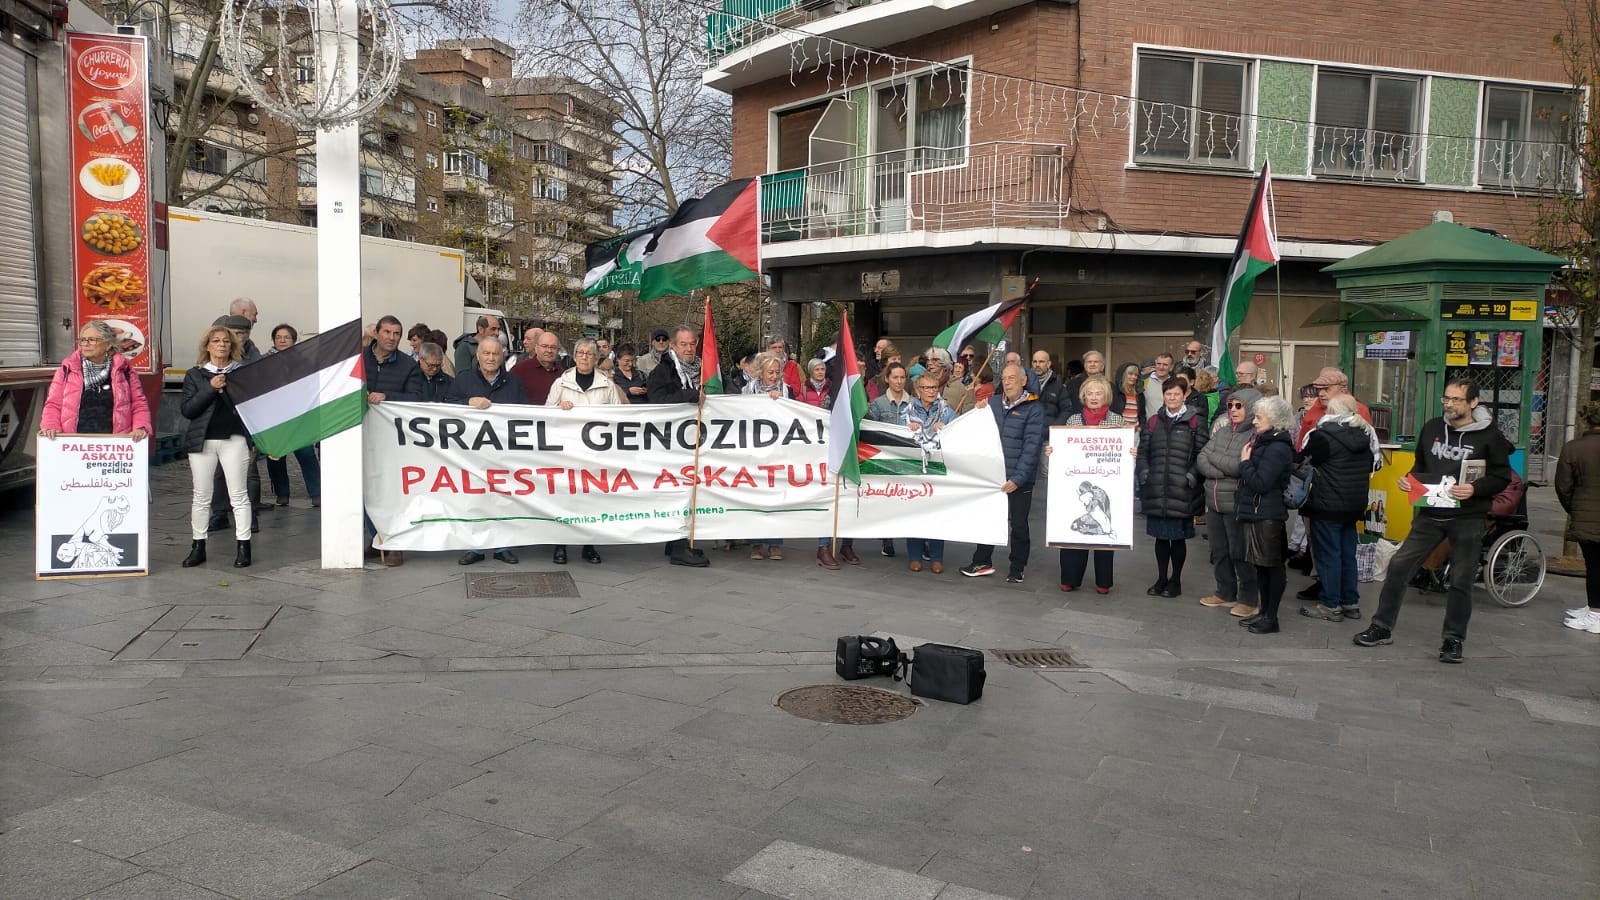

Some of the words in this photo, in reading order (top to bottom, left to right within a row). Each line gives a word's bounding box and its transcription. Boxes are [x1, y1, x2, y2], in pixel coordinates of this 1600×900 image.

[83, 51, 130, 72] CHURRERIA
[1493, 304, 1506, 312] 120
[1450, 340, 1466, 349] 120
[394, 417, 563, 451] ISRAEL
[581, 418, 825, 451] GENOZIDA!
[62, 443, 134, 452] PALESTINA
[81, 452, 134, 461] ASKATU
[86, 460, 133, 469] genozidioa
[101, 467, 132, 475] gelditu
[401, 465, 639, 496] PALESTINA
[653, 462, 828, 489] ASKATU!
